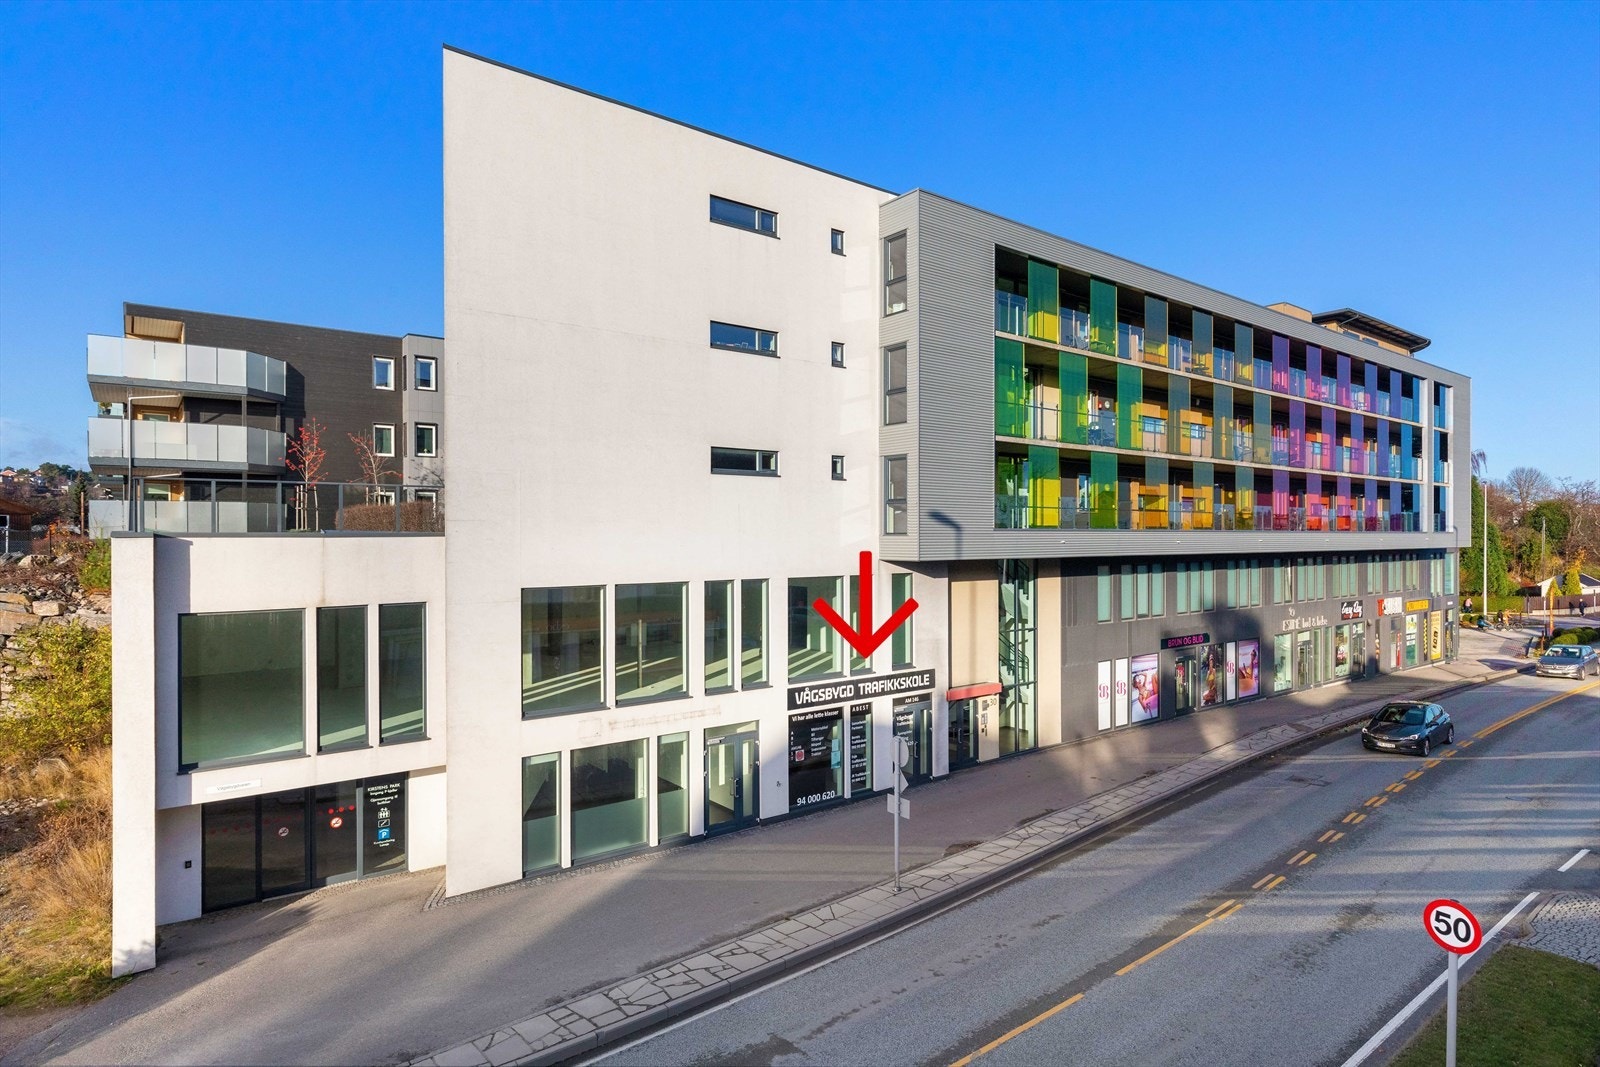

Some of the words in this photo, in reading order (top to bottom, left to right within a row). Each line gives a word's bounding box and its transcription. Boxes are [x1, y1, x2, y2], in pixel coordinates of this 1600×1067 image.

[1167, 637, 1182, 648] BRUN
[1183, 636, 1192, 645] OG
[795, 684, 854, 705] VÅGSBYGD
[858, 674, 930, 696] TRAFIKKSKOLE
[824, 710, 839, 718] klasser
[796, 797, 806, 806] 94
[808, 794, 821, 804] 000
[822, 790, 835, 801] 620
[1433, 910, 1471, 943] 50
